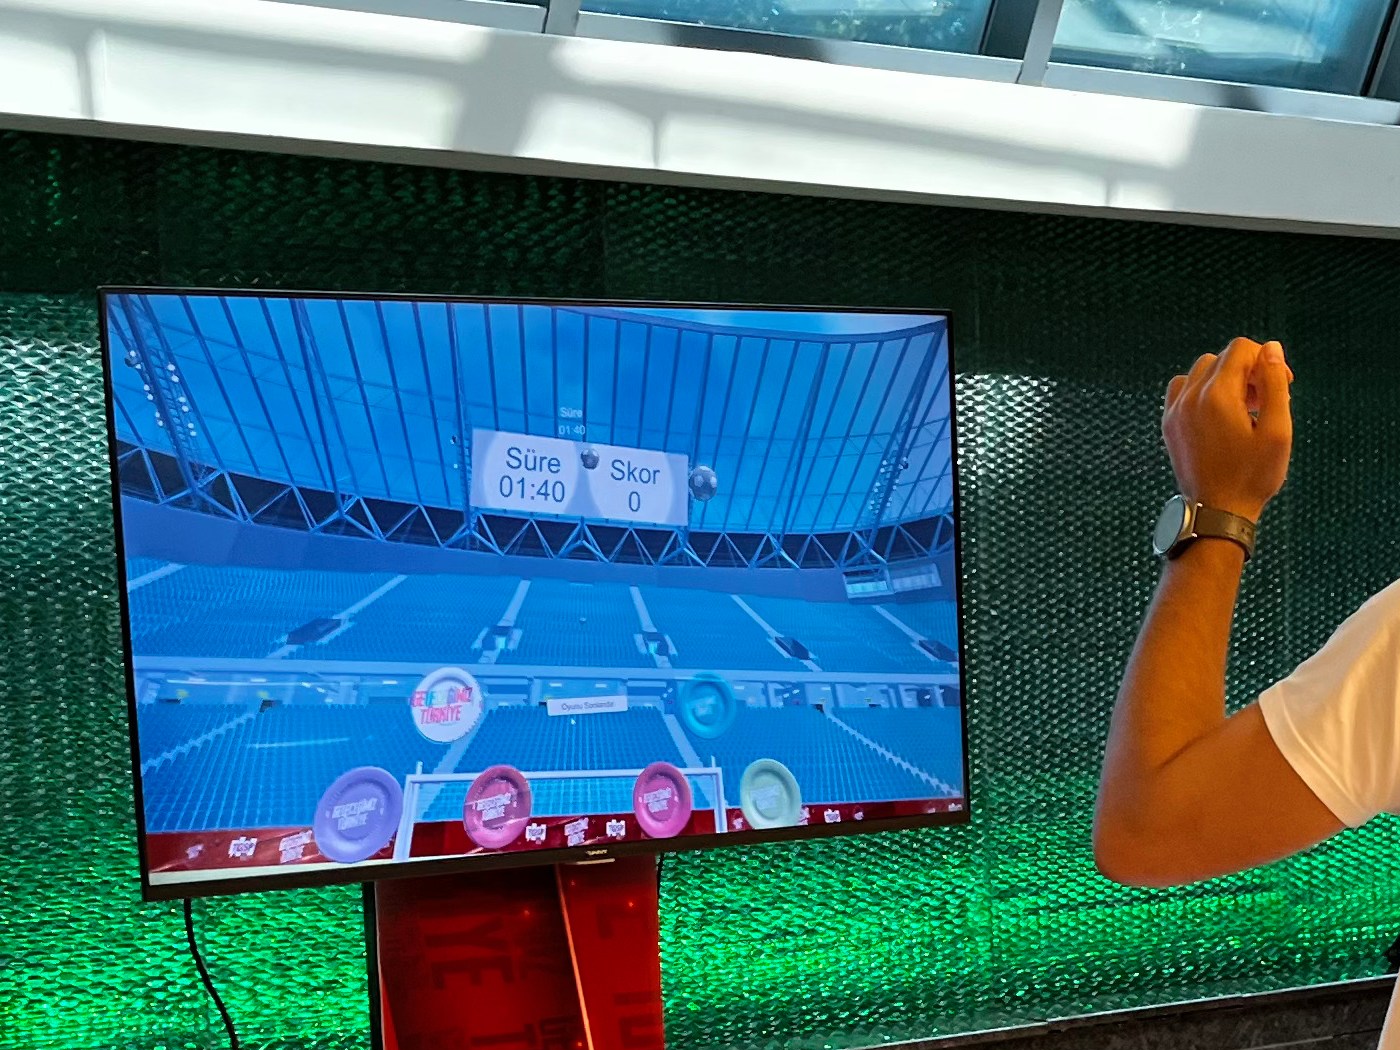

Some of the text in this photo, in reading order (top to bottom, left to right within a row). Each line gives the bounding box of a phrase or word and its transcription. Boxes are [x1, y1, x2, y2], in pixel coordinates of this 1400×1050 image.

[560, 406, 583, 418] Süre
[558, 425, 586, 436] 01:40
[505, 446, 562, 474] Süre
[610, 459, 661, 485] Skor
[499, 475, 566, 503] 01:40
[628, 491, 641, 513] 0
